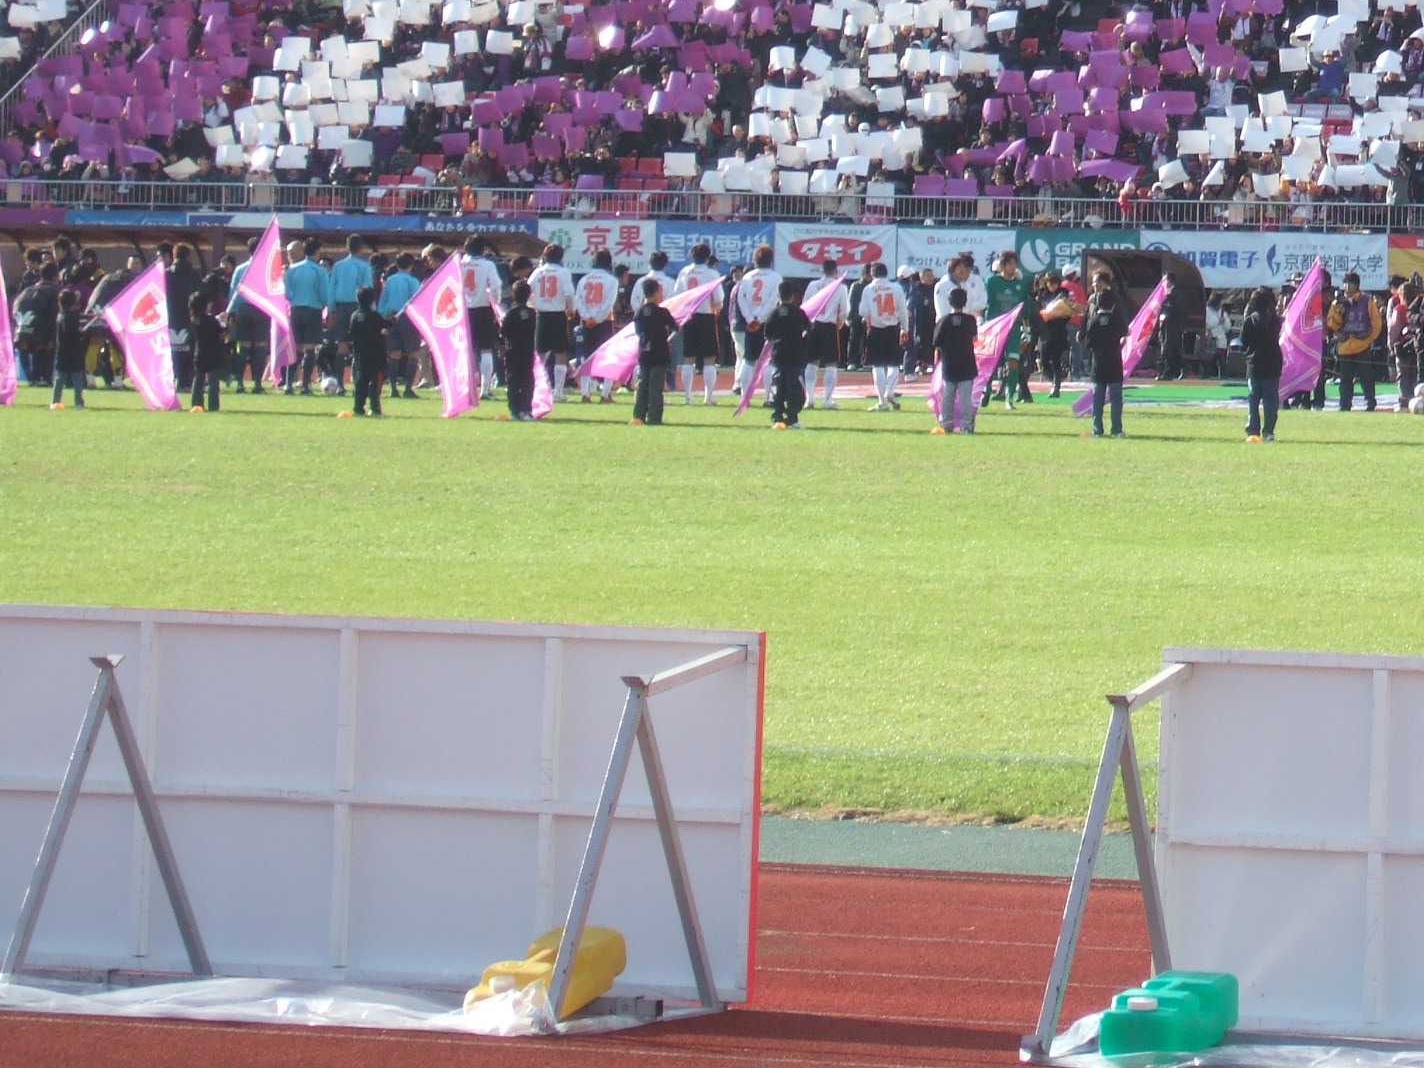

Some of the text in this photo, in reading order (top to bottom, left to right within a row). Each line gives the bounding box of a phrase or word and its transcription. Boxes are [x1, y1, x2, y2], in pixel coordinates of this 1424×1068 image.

[582, 225, 643, 257] 京果
[801, 243, 867, 261] タキイ
[1283, 253, 1383, 273] 京都学園大学
[537, 275, 558, 297] 13
[752, 278, 763, 302] 2
[872, 292, 895, 316] 14
